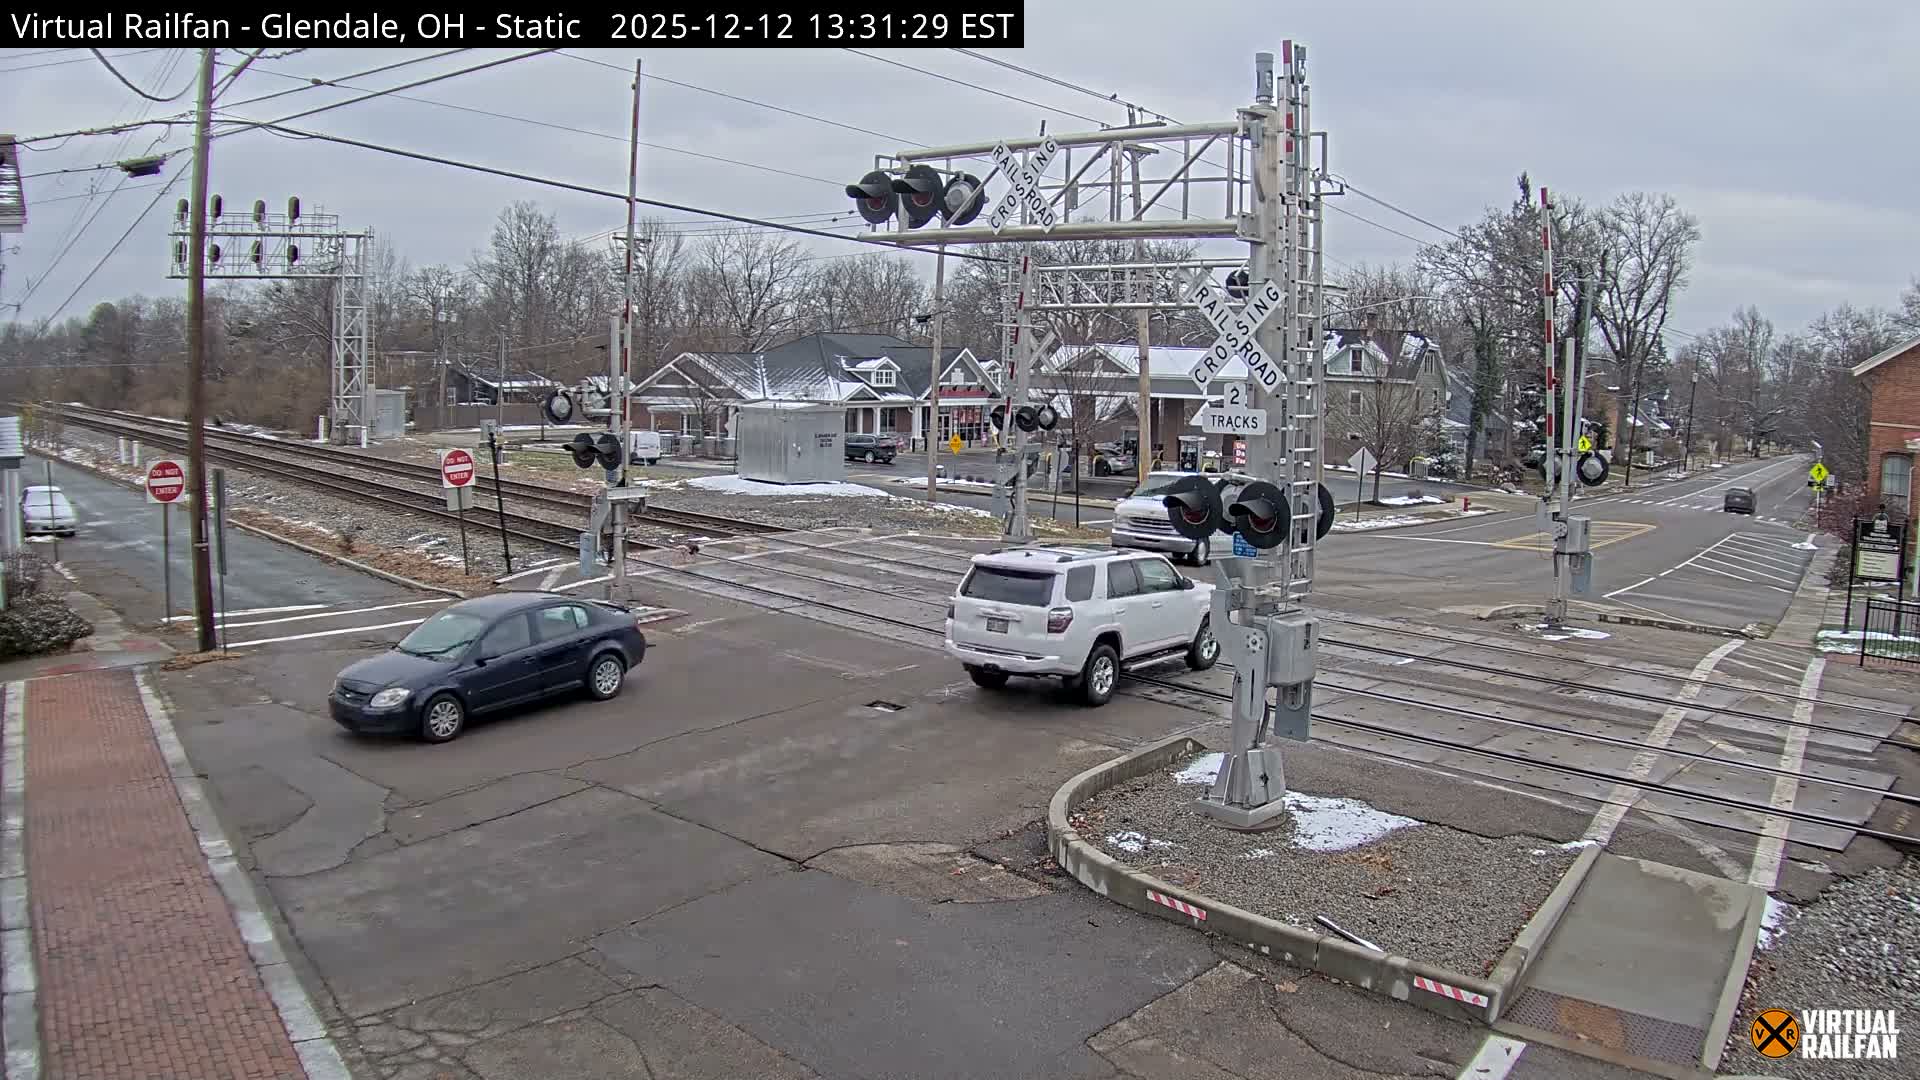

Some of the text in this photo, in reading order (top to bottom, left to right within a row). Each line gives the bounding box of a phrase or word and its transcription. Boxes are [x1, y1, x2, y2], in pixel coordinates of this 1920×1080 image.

[990, 140, 1055, 229] CROSSING
[993, 145, 1054, 227] RAILROAD
[1194, 286, 1279, 384] CROSSING
[1195, 286, 1277, 386] RAILROAD
[1230, 388, 1240, 405] 2
[1211, 414, 1258, 429] TRACKS
[152, 468, 179, 477] DO NOT
[155, 486, 177, 495] ENTER
